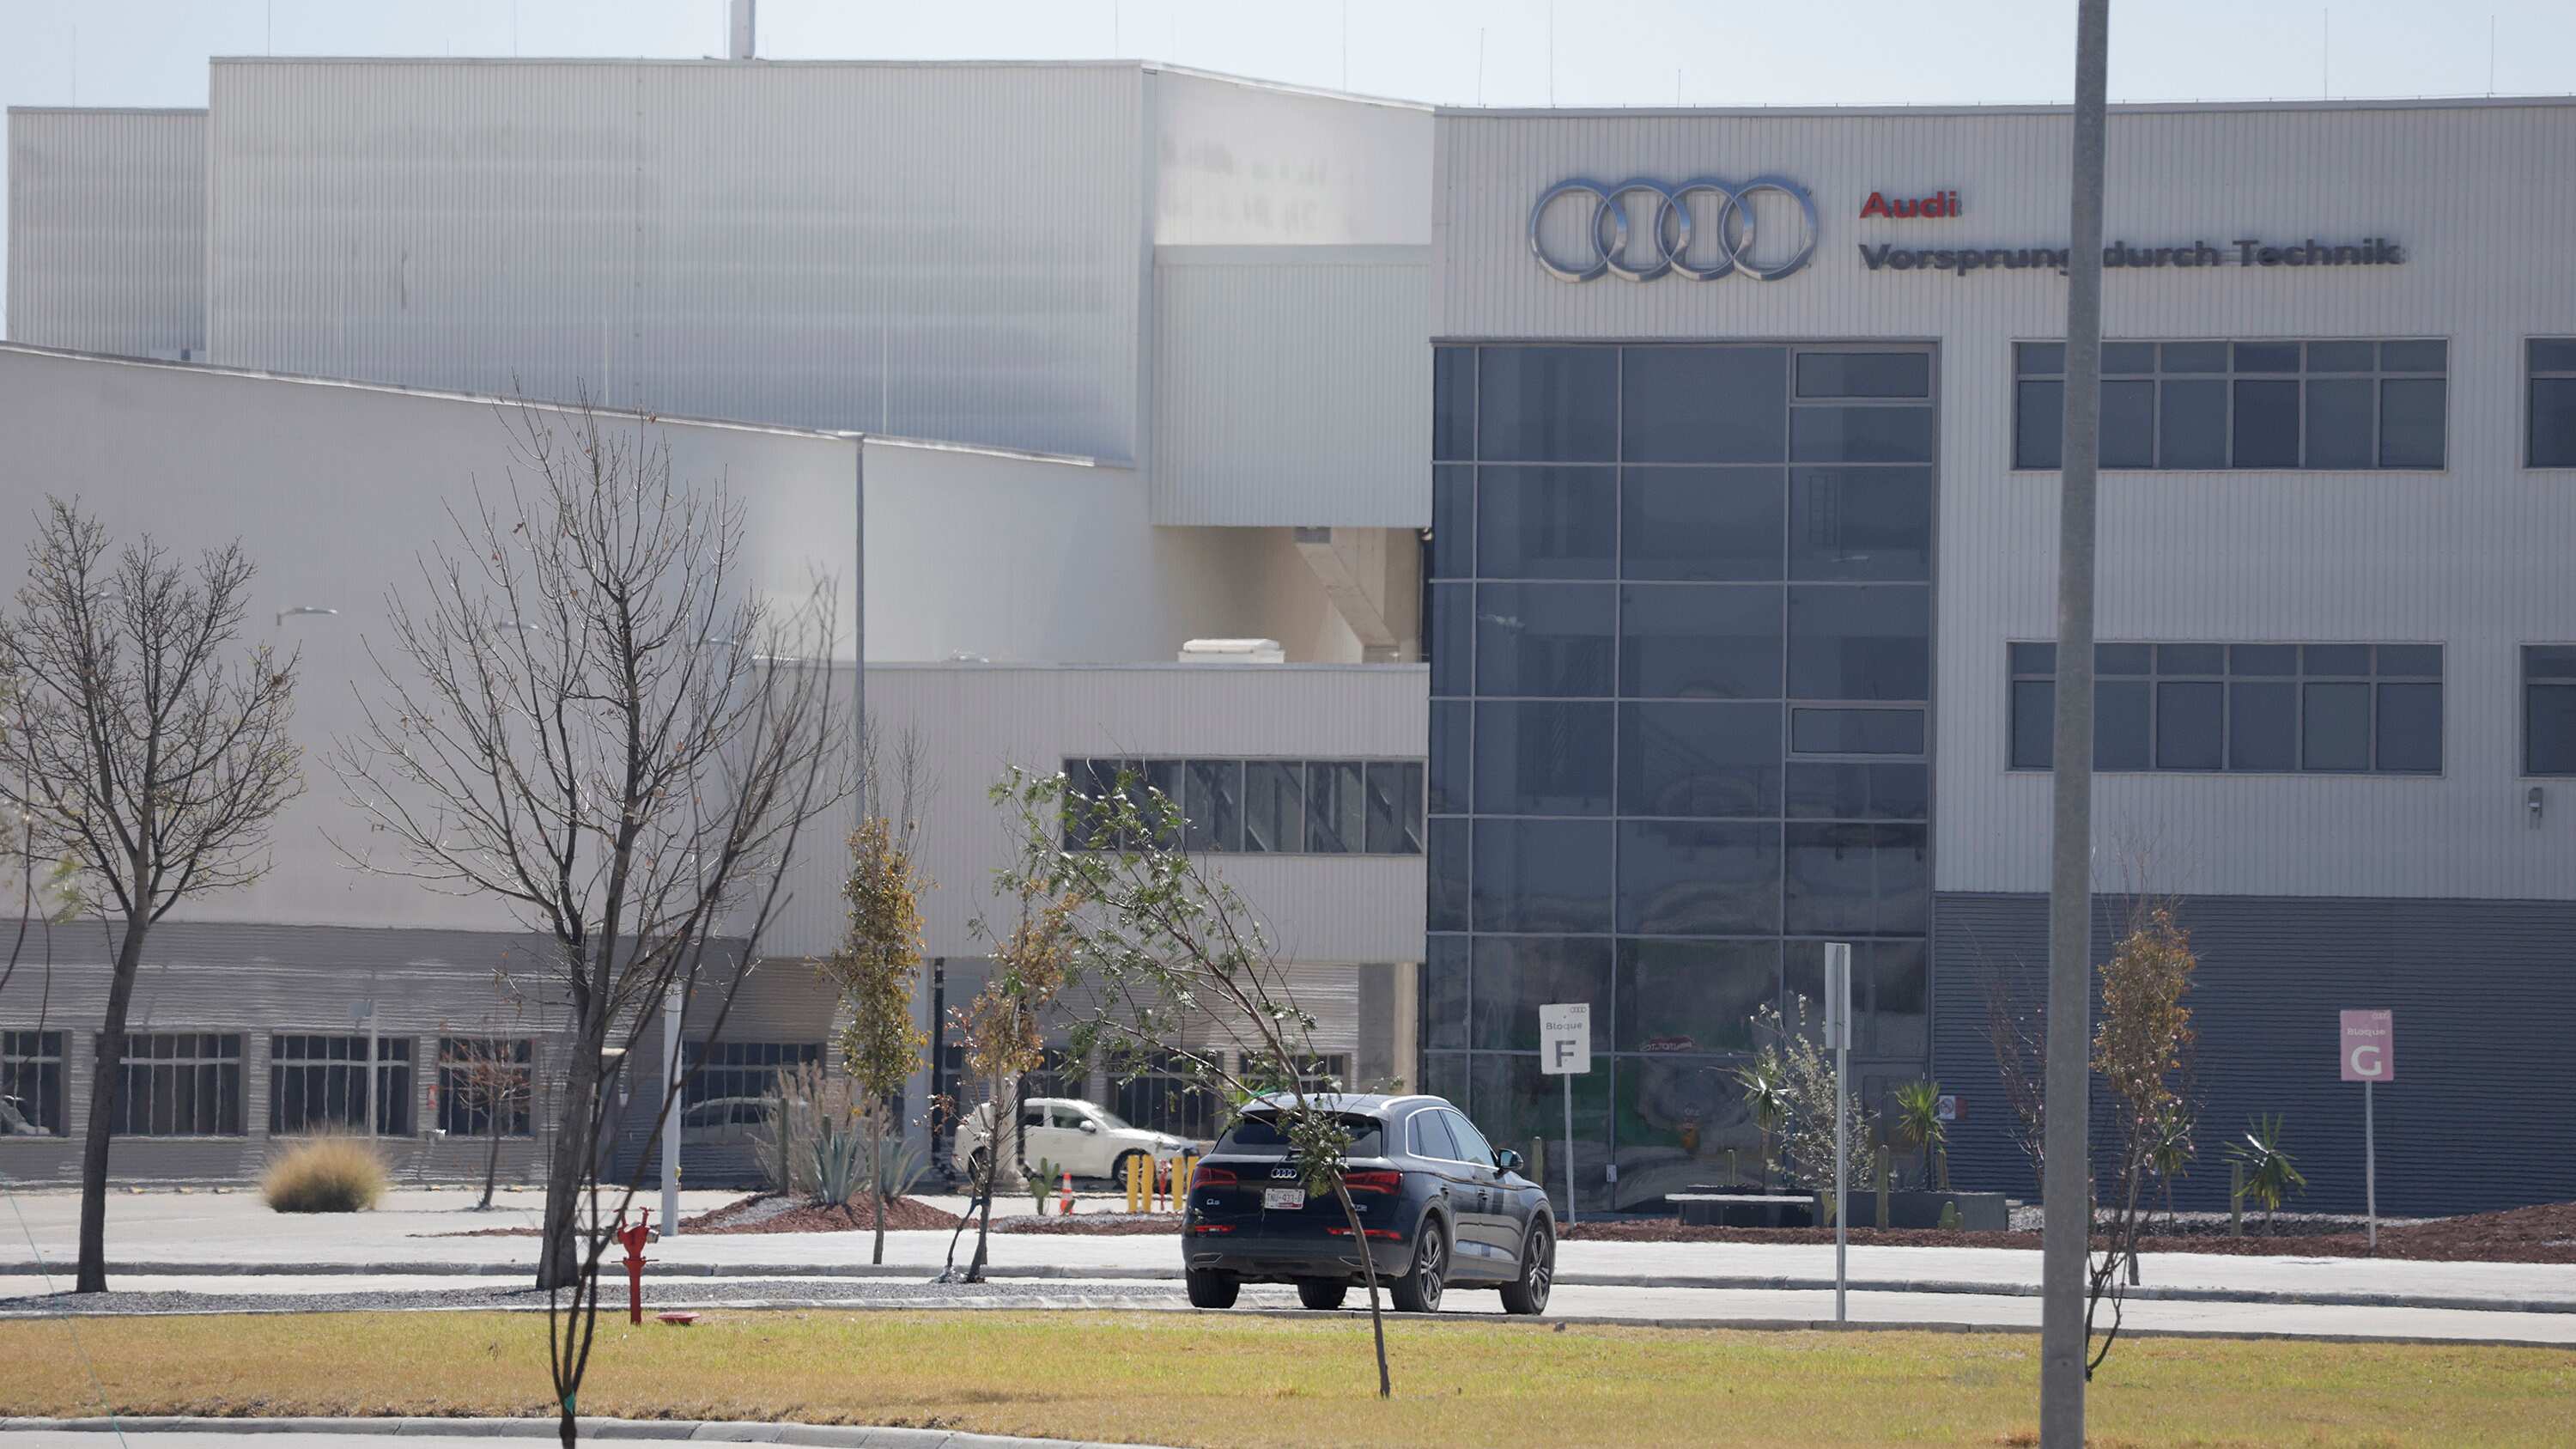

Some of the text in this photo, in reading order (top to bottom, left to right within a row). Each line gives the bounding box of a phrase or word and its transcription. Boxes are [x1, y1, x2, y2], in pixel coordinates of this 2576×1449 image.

[1859, 191, 1959, 219] Audi
[2101, 240, 2221, 268] durch
[2232, 237, 2403, 267] Technik
[1545, 1022, 1583, 1032] Bloque
[2347, 1028, 2386, 1038] Bloque
[1555, 1040, 1577, 1068] F
[2350, 1044, 2383, 1076] G
